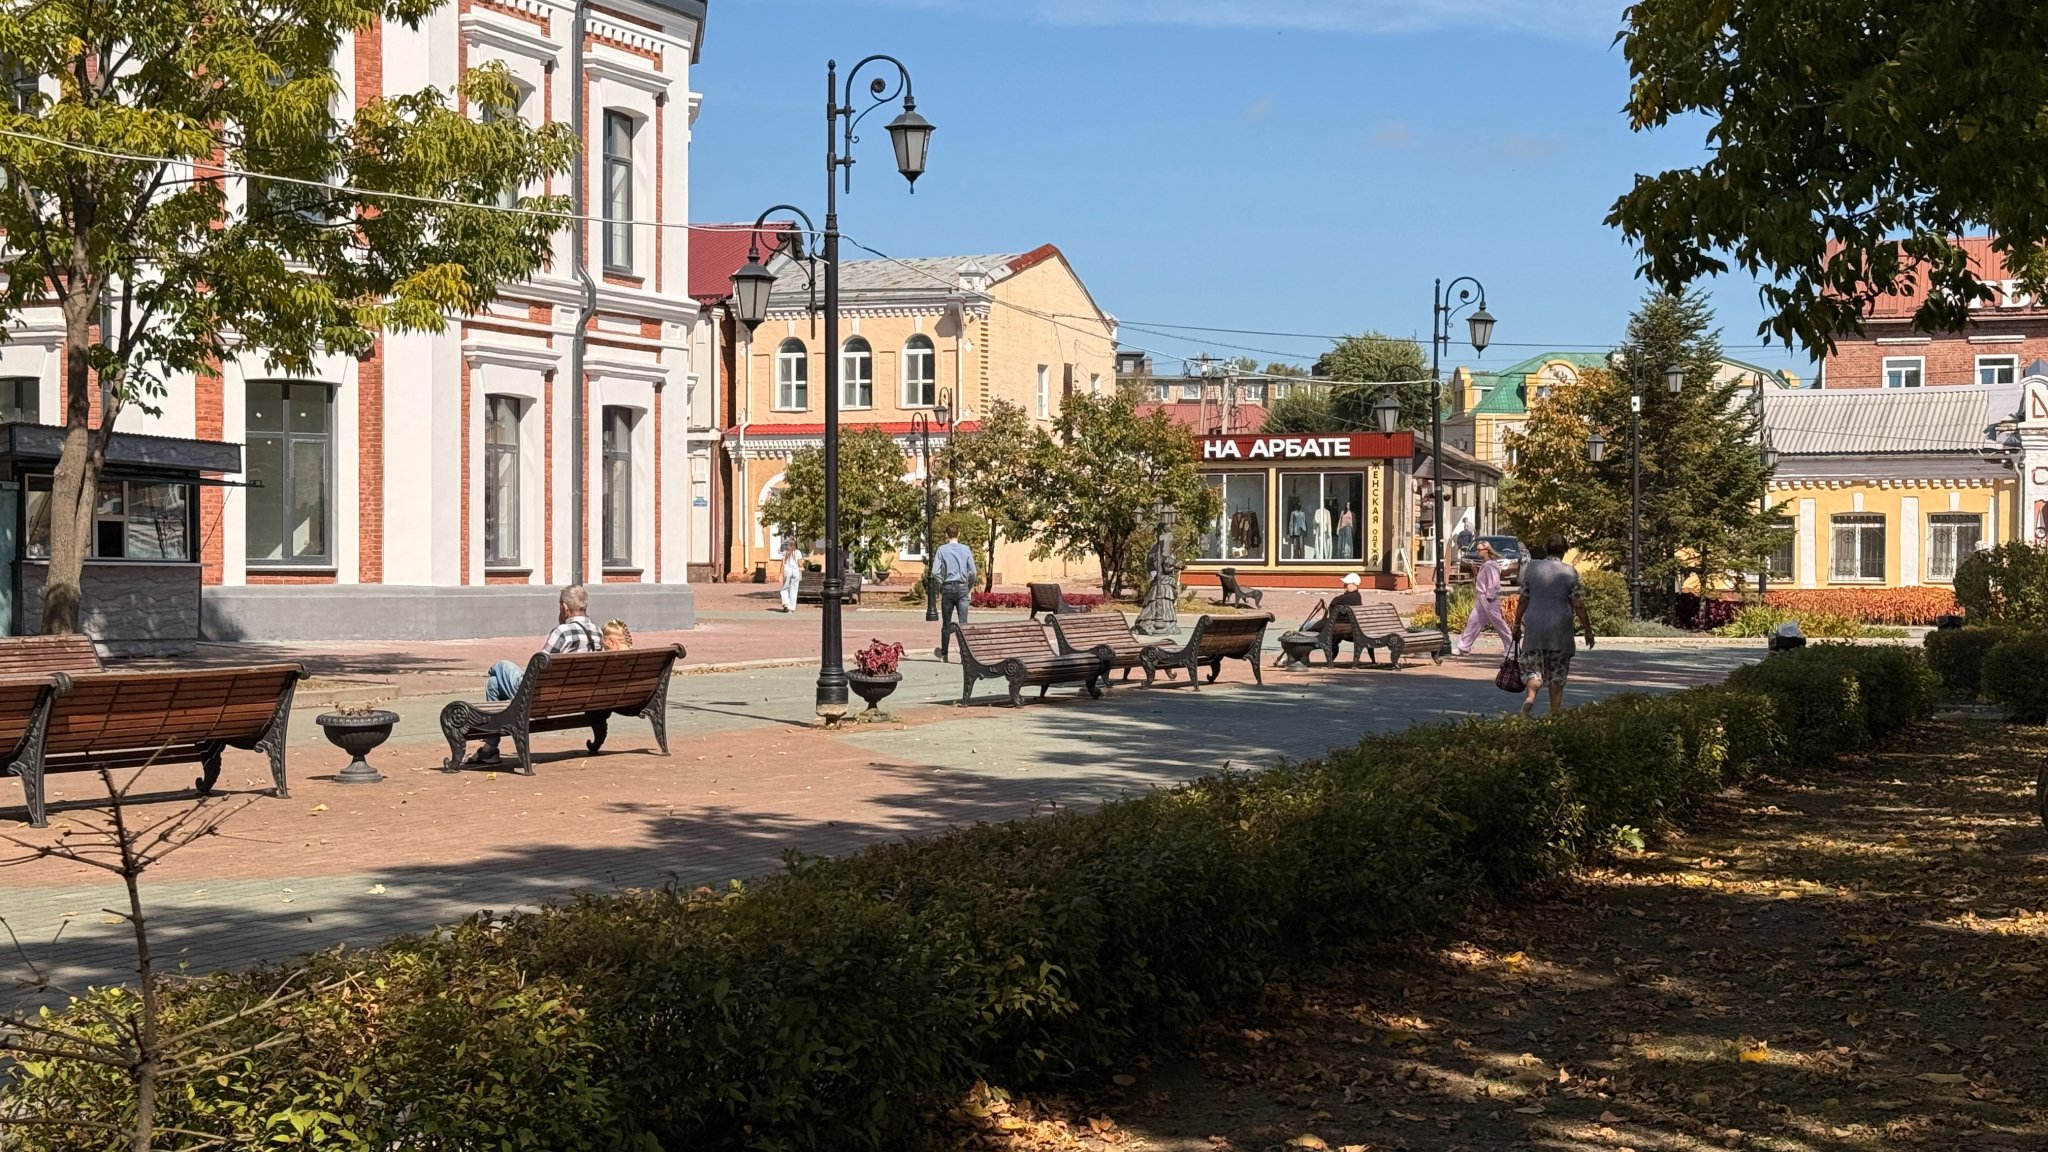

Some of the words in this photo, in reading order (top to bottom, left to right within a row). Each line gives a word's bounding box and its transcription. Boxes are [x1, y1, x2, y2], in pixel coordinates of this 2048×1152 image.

[1203, 439, 1242, 459] НА
[1249, 437, 1351, 458] АРБАТЕ
[1371, 461, 1381, 524] ЖЕНСКАЯ
[1371, 529, 1380, 567] ОДЕЖДА
